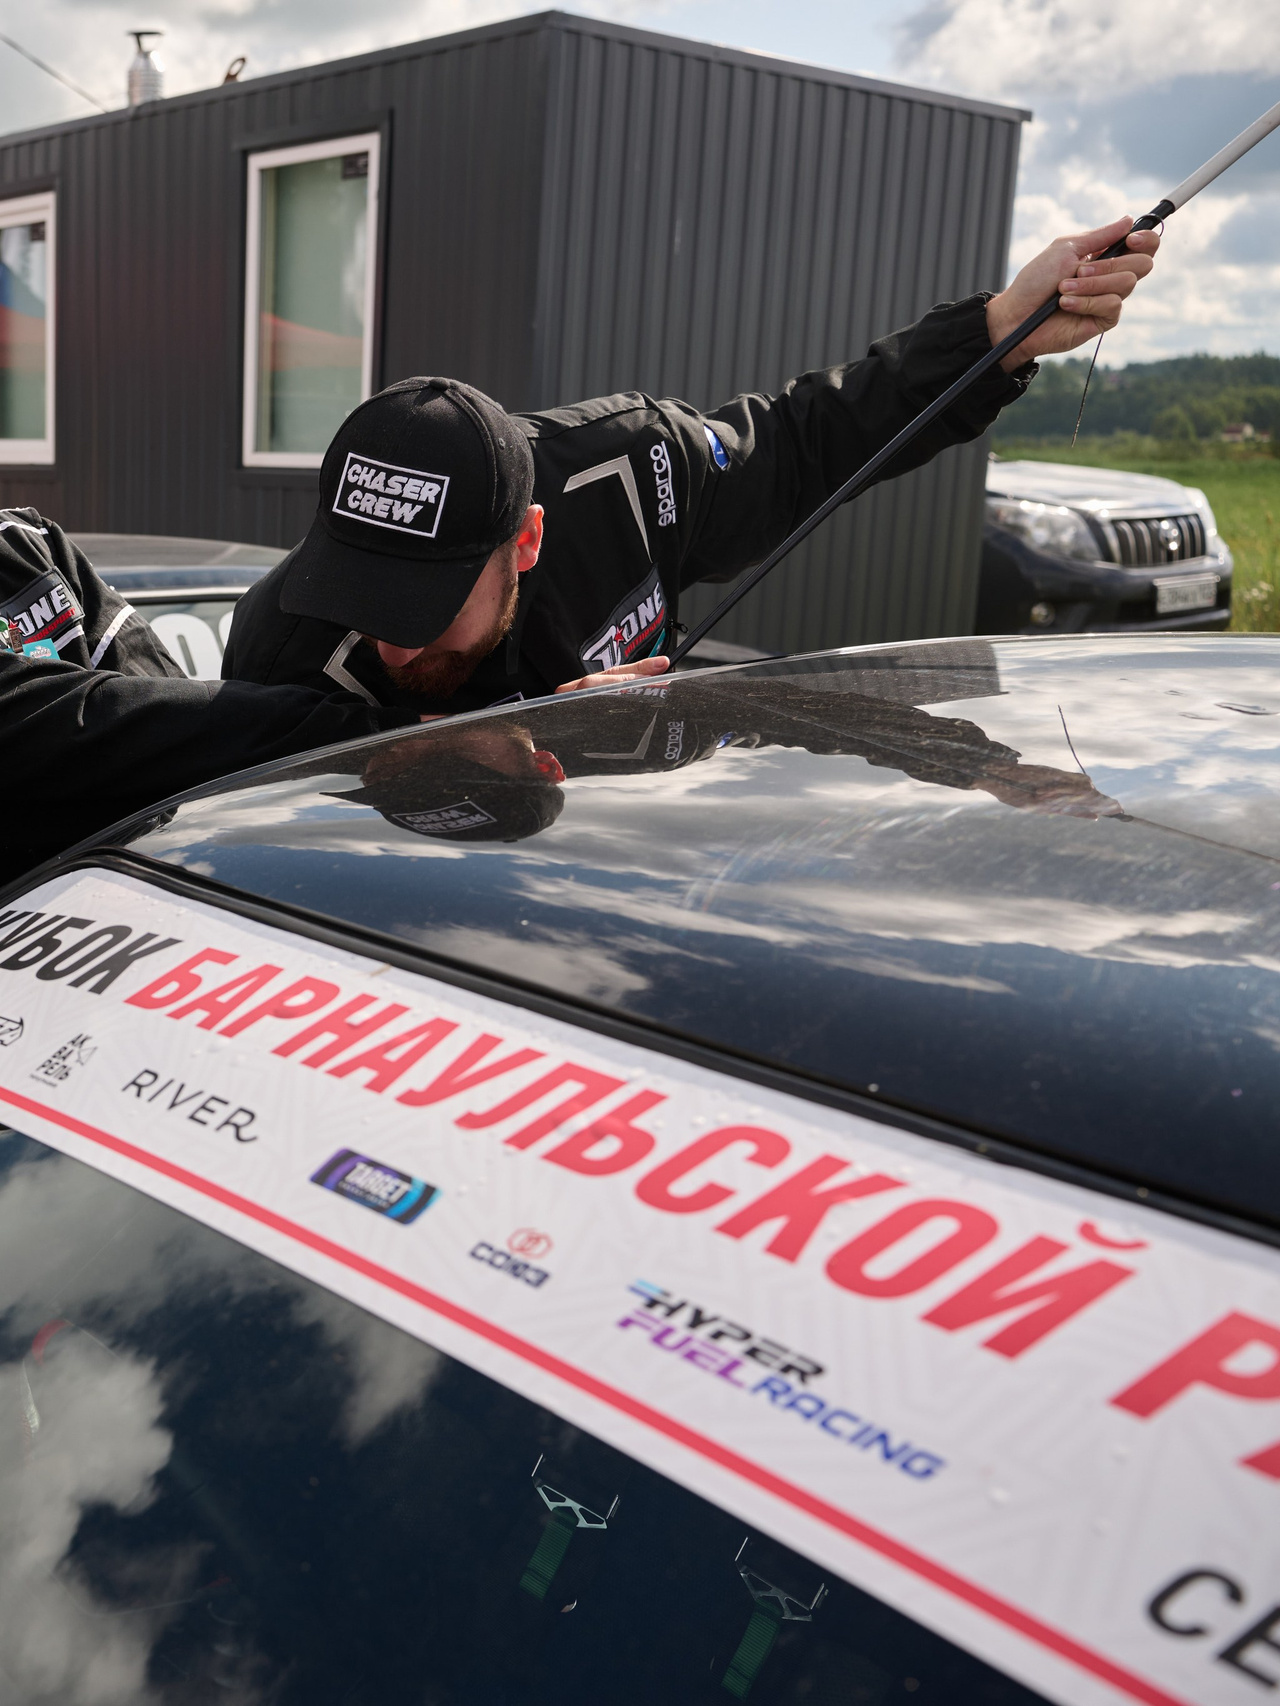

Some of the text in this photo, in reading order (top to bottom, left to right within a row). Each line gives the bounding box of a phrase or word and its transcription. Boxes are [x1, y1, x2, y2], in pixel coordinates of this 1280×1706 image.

[347, 463, 441, 504] CHASER
[347, 489, 424, 524] CREW
[650, 440, 677, 528] sparco
[120, 1068, 259, 1145] RIVER
[123, 948, 1150, 1361] БАРНАУЛЬСКОЙ
[1106, 1310, 1280, 1482] Р
[343, 1161, 413, 1205] TARGET
[636, 1282, 826, 1386] HYPER
